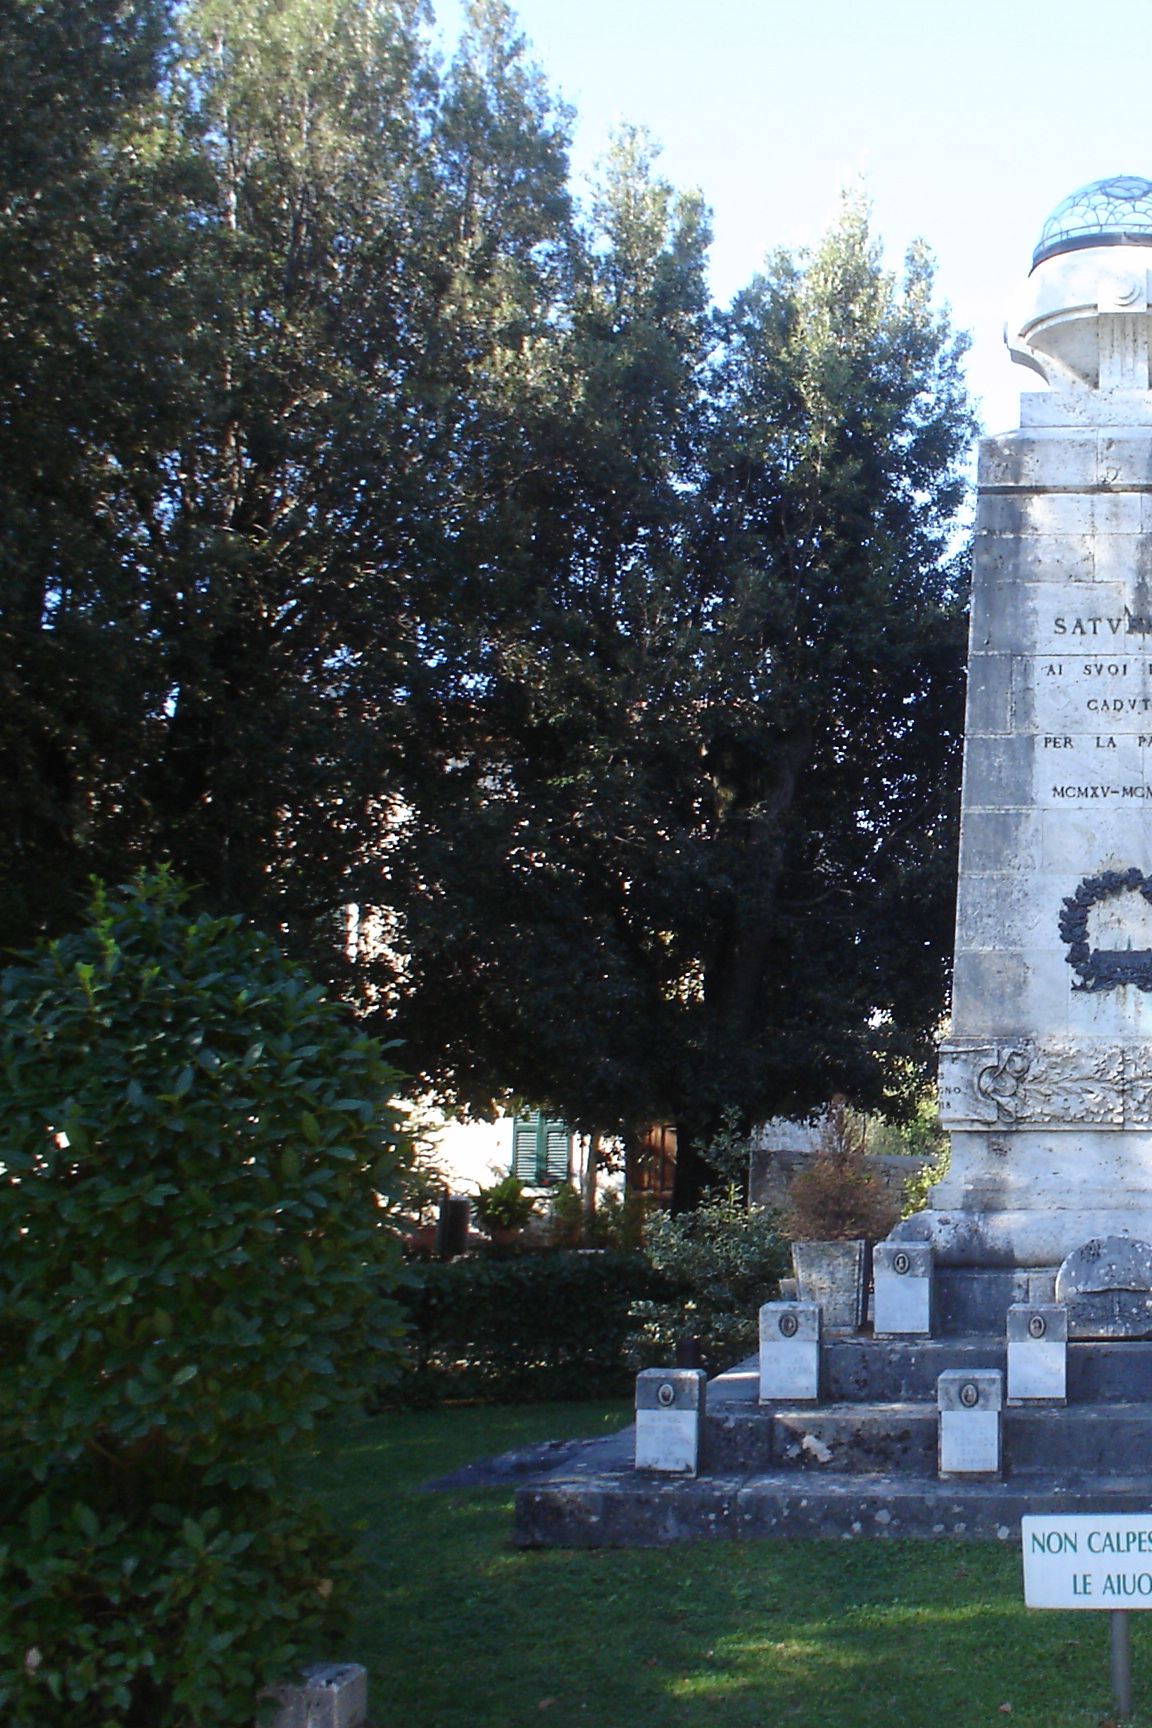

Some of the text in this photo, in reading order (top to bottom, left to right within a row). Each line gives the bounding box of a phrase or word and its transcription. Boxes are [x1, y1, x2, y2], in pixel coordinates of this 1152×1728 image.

[1046, 663, 1063, 676] AI
[1083, 663, 1128, 676] SVOI
[1044, 736, 1074, 749] PER
[1096, 736, 1117, 748] LA
[1031, 1531, 1078, 1553] NON
[1072, 1573, 1092, 1595] LE
